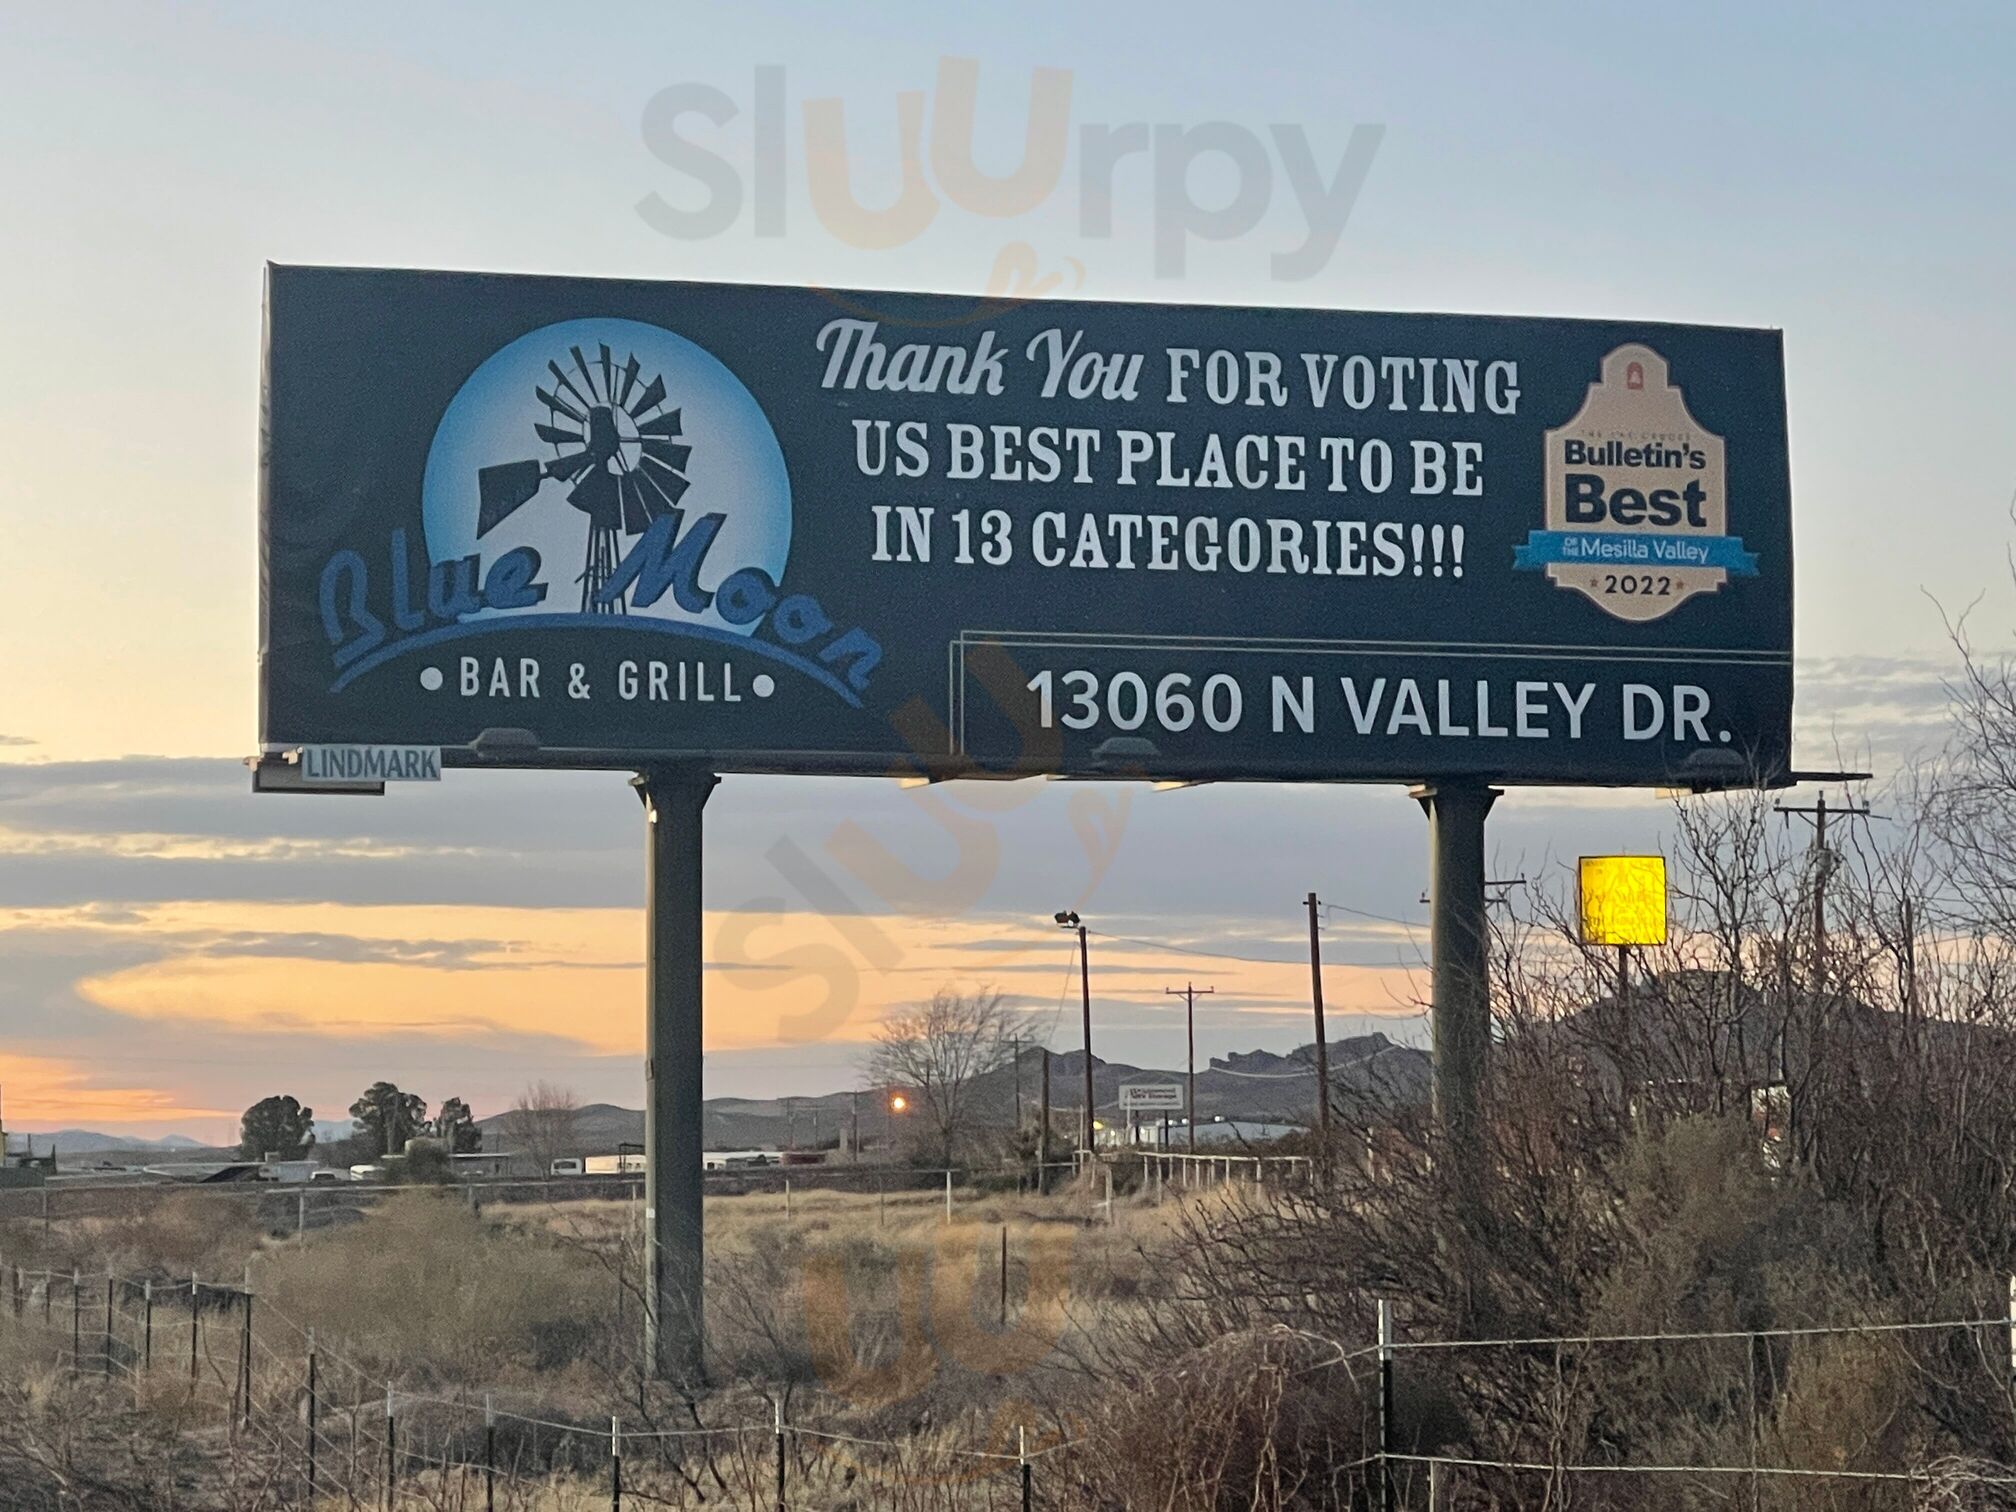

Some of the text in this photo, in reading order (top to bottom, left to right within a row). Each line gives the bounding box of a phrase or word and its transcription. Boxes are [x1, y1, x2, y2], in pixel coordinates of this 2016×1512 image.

[816, 318, 1521, 415] Thank You FOR VOTING
[851, 419, 1484, 496] US BEST PLACE TO BE
[1564, 473, 1708, 529] Best
[871, 505, 1466, 578] IN 13 CATEGORIES!!!
[1581, 537, 1709, 563] Mesilla Valley
[318, 511, 884, 690] Blue Moon
[1604, 575, 1671, 596] 2022
[460, 656, 742, 702] BAR & GRILL
[1026, 669, 1732, 743] 13060 N VALLEY DR.
[307, 748, 436, 779] LINDMARK
